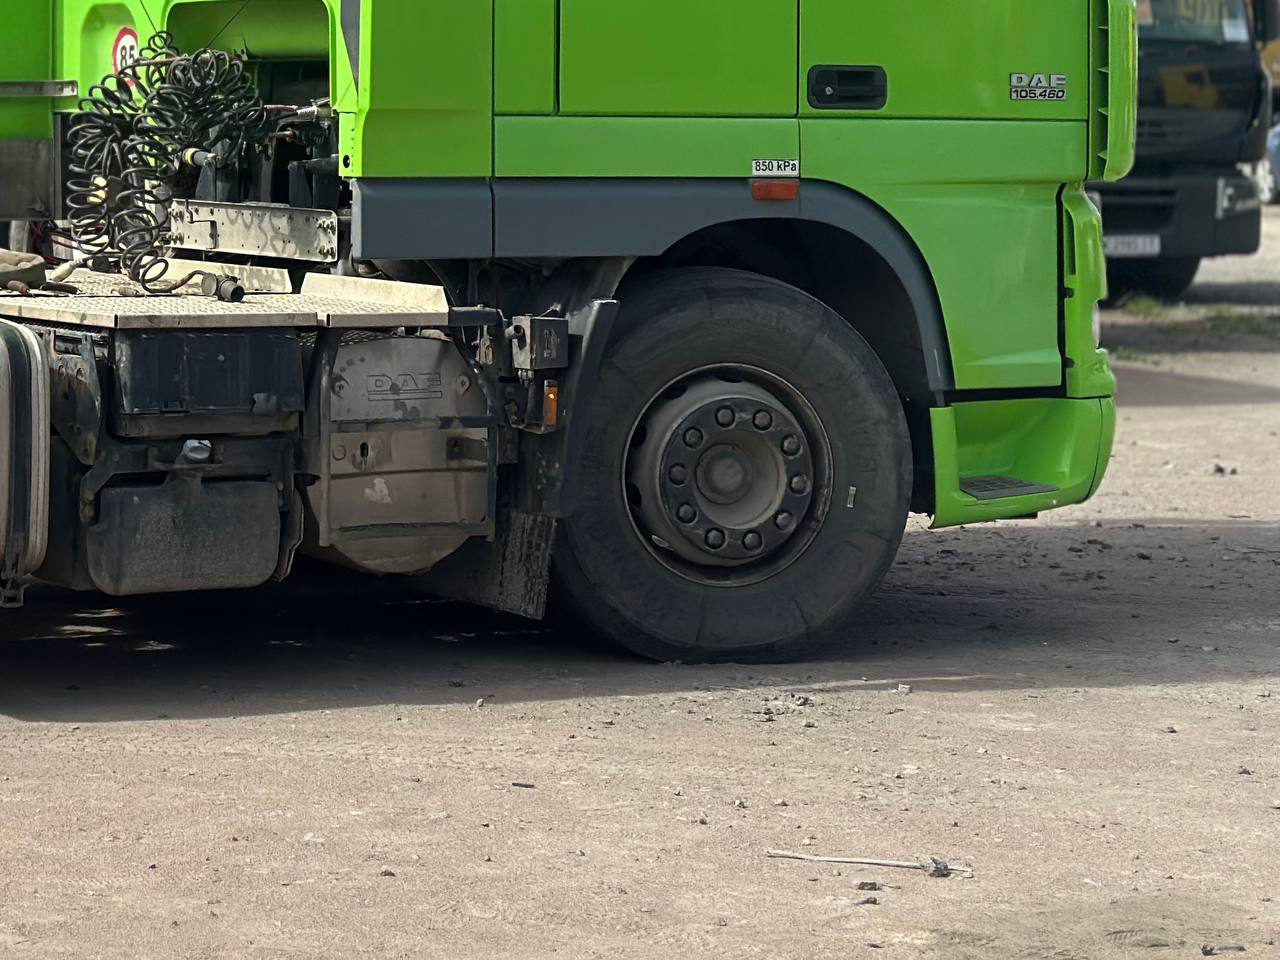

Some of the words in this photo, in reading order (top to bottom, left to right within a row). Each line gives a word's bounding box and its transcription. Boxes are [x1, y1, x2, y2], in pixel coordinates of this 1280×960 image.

[1009, 73, 1066, 88] DAF
[1012, 89, 1065, 99] 105.460
[755, 160, 774, 171] 850
[776, 160, 797, 171] kPa
